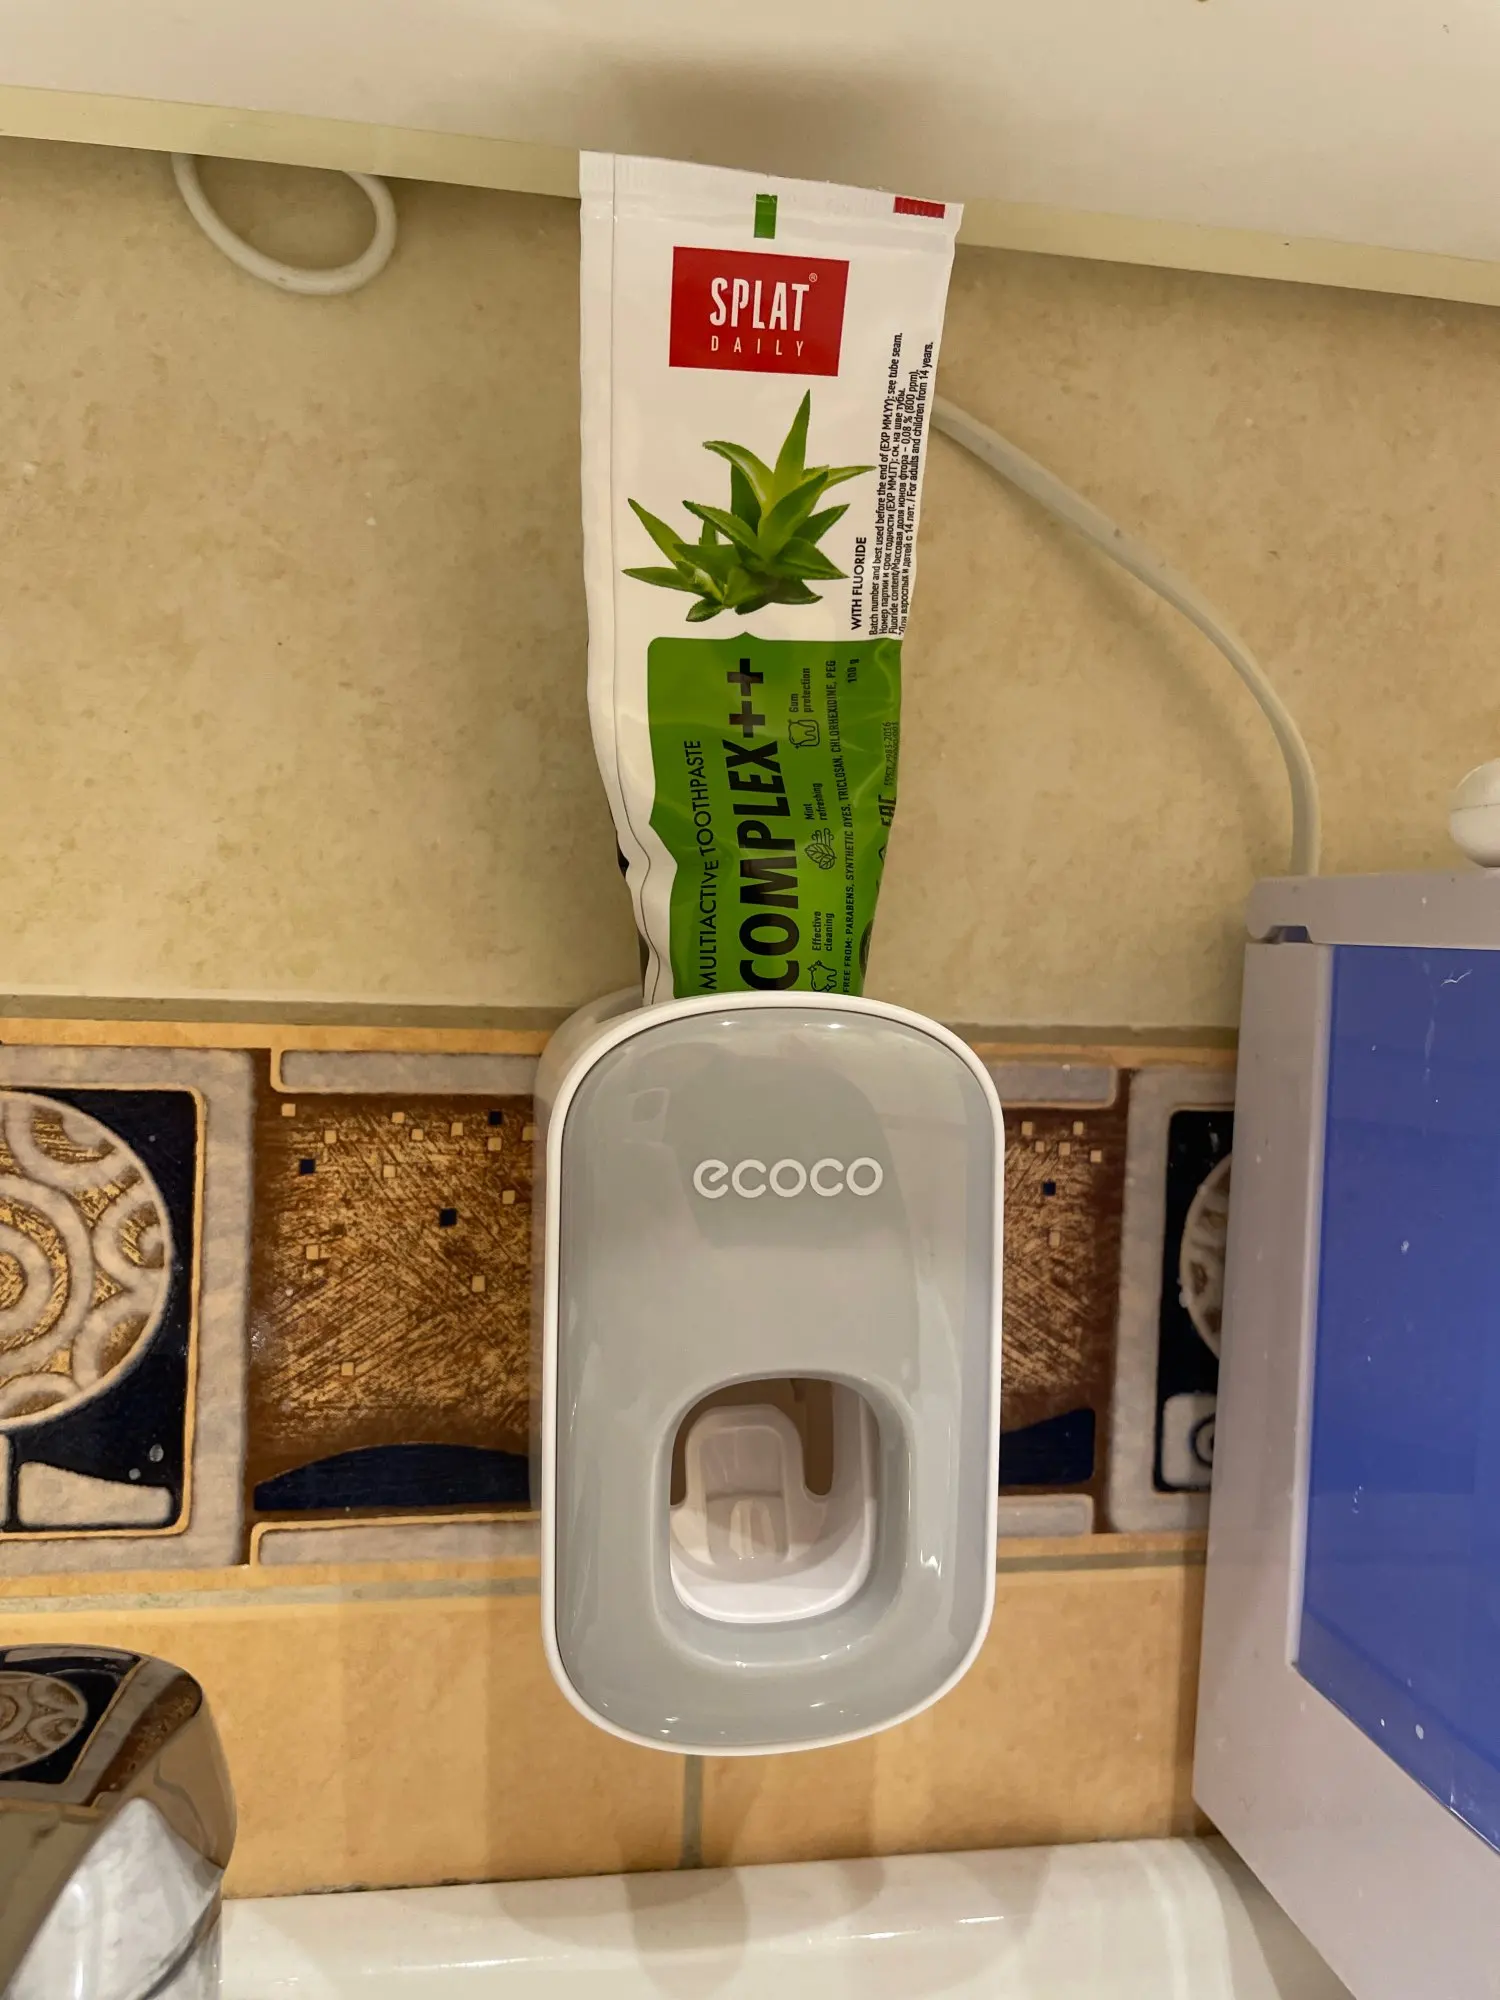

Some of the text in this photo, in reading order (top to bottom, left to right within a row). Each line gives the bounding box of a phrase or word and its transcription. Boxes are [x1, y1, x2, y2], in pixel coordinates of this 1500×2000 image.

[711, 335, 804, 357] DAILY
[890, 332, 902, 357] seam.
[922, 341, 934, 368] years.
[888, 359, 899, 378] tube
[919, 370, 929, 380] 14
[885, 380, 897, 395] see
[907, 369, 919, 392] ppm).
[916, 382, 927, 400] from
[896, 387, 906, 410] тубы.
[904, 394, 916, 414] (800
[894, 412, 903, 430] шве
[912, 403, 925, 437] children
[880, 431, 892, 452] (EXP
[893, 432, 901, 443] на
[901, 426, 912, 445] 0,08
[911, 438, 920, 454] and
[879, 453, 888, 463] of
[898, 454, 911, 481] фтора
[908, 455, 919, 481] adults
[878, 464, 888, 480] end
[877, 482, 887, 496] the
[898, 482, 907, 508] ионов
[906, 482, 916, 497] For
[875, 497, 886, 524] before
[897, 509, 905, 530] доля
[906, 504, 915, 522] лет.
[874, 526, 885, 545] used
[885, 514, 895, 551] годности
[904, 523, 914, 533] 14
[872, 547, 882, 564] best
[883, 552, 892, 571] срок
[902, 543, 912, 567] детей
[851, 537, 867, 631] WITH FLUORIDE
[872, 566, 881, 580] and
[869, 582, 879, 611] number
[881, 579, 890, 607] партии
[900, 575, 909, 614] взрослых
[868, 613, 879, 636] Batch
[879, 609, 891, 634] Номер
[888, 602, 898, 634] Fluoride
[826, 660, 836, 678] PEG
[847, 666, 858, 683] 100
[801, 668, 813, 713] protection
[789, 693, 799, 713] Gum
[826, 681, 842, 752] CHLORHEXIDINE,
[832, 754, 847, 801] TRICLOSAN,
[803, 803, 814, 820] Mint
[812, 783, 827, 820] refreshing
[684, 740, 719, 990] MULTIACTIVE TOOTHPASTE
[844, 830, 855, 880] SYNTHETIC
[845, 883, 855, 935] PARABENS,
[811, 911, 822, 951] Effective
[824, 913, 835, 951] cleaning
[844, 937, 853, 967] FROM:
[842, 970, 851, 993] FREE
[693, 1156, 883, 1198] ecoco
